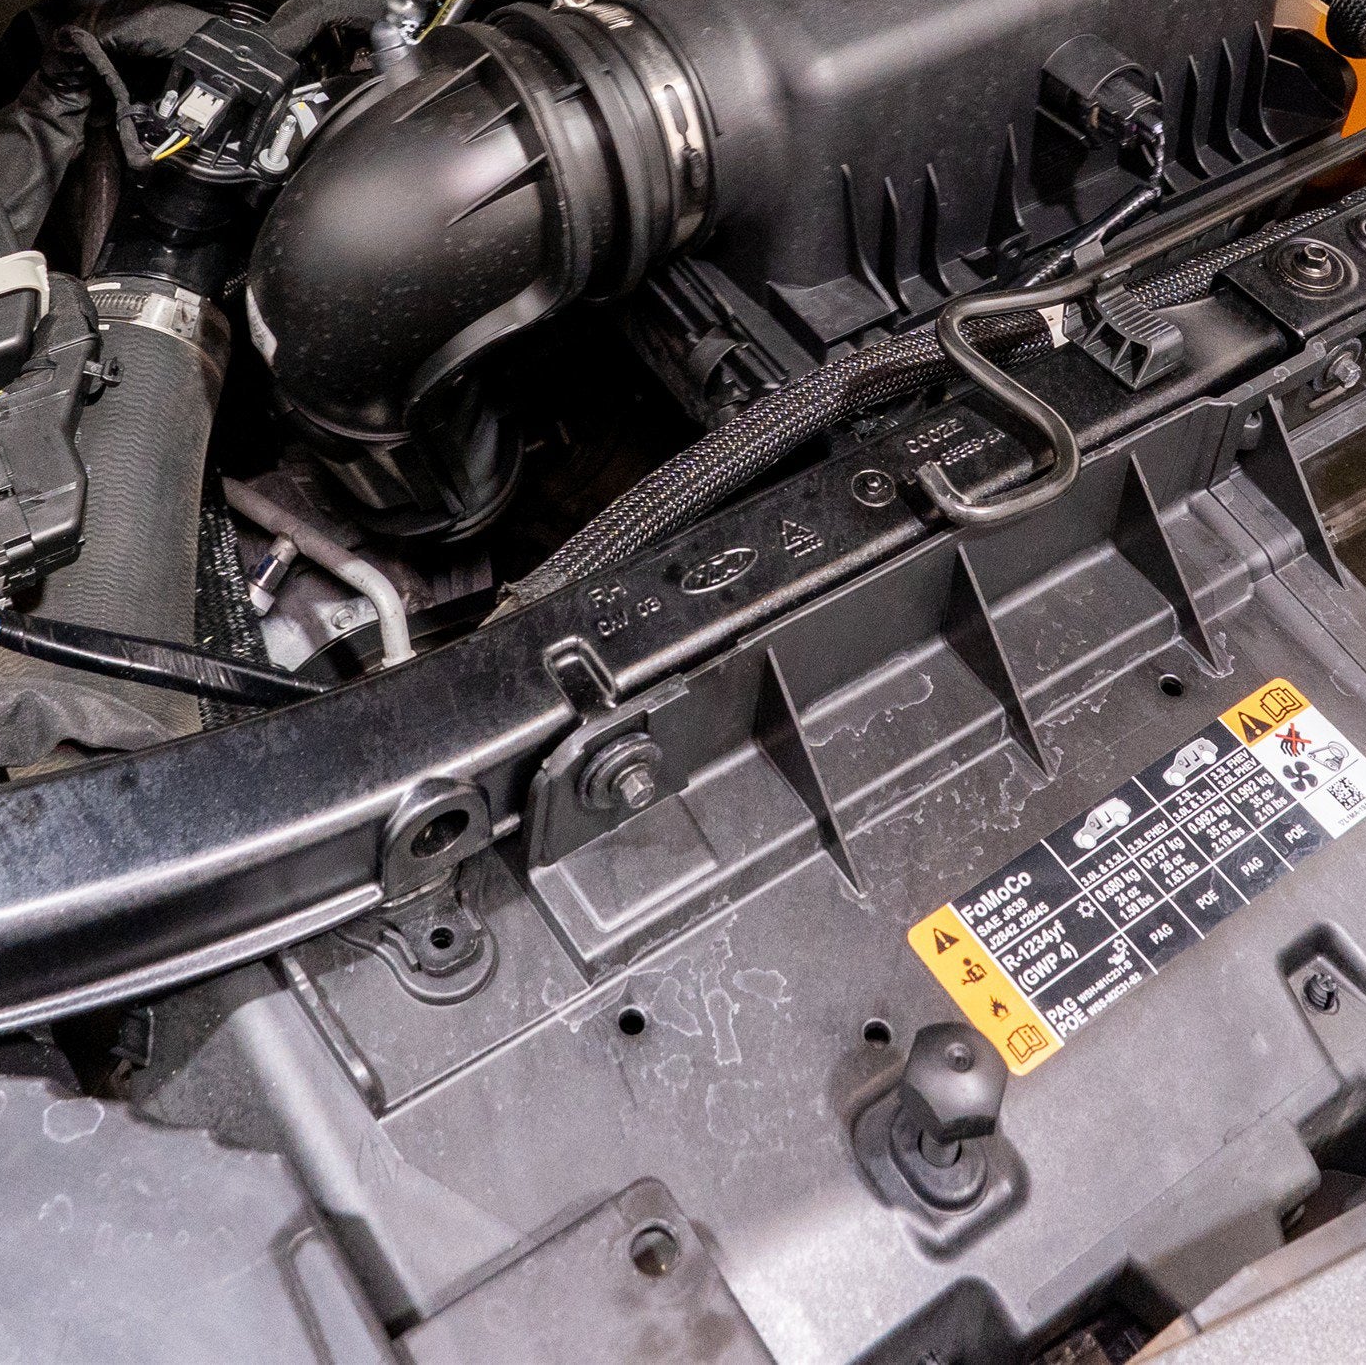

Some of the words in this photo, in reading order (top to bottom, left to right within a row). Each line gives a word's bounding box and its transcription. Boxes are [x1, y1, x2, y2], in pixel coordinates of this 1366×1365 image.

[1210, 766, 1230, 780] 3.3L
[1226, 750, 1248, 769] FHEV
[1218, 774, 1237, 788] 3.0L
[1234, 758, 1256, 777] PHEV
[1176, 790, 1198, 805] 2.3L,
[1231, 780, 1260, 803] 0.992
[1255, 773, 1274, 786] kg
[1250, 795, 1263, 808] 35
[1262, 790, 1274, 800] oz
[1173, 806, 1192, 821] 3.0L
[1190, 800, 1199, 809] &
[1196, 789, 1216, 804] 3.3L
[1187, 810, 1217, 834] 0.992
[1212, 803, 1231, 816] kg
[1255, 804, 1274, 822] 2.19
[1271, 797, 1287, 809] lbs
[1127, 838, 1147, 853] 3.3L
[1144, 821, 1168, 841] FHEV
[1206, 826, 1220, 839] 35
[1219, 820, 1231, 831] oz
[1211, 835, 1232, 853] 2.19
[1228, 827, 1245, 840] lbs
[1285, 824, 1307, 843] POE
[1140, 844, 1169, 869] 0.737
[1166, 836, 1185, 851] kg
[1160, 860, 1174, 874] 26
[1172, 854, 1185, 866] oz
[1241, 857, 1263, 876] PAG
[1081, 871, 1101, 886] 3.0L
[1099, 865, 1109, 874] &
[1106, 853, 1126, 868] 3.3L
[1165, 870, 1185, 887] 1.63
[1181, 862, 1199, 875] lbs
[961, 872, 1031, 925] FoMoCo
[1095, 877, 1125, 902] 0.680
[1121, 869, 1141, 883] kg
[1114, 893, 1129, 907] 24
[1128, 886, 1140, 898] oz
[1196, 889, 1219, 909] POE
[977, 915, 1003, 937] SAE
[1002, 898, 1027, 920] J639
[1120, 903, 1140, 920] 1.50
[1137, 894, 1154, 908] lbs
[989, 923, 1019, 950] J2842
[1019, 902, 1049, 928] J2845
[1150, 924, 1173, 944] PAG
[1002, 920, 1065, 971] R-1234yf
[1018, 953, 1057, 992] (GWP
[1060, 942, 1078, 959] 4)
[1046, 998, 1077, 1025] PAG
[1056, 1009, 1088, 1038] POE
